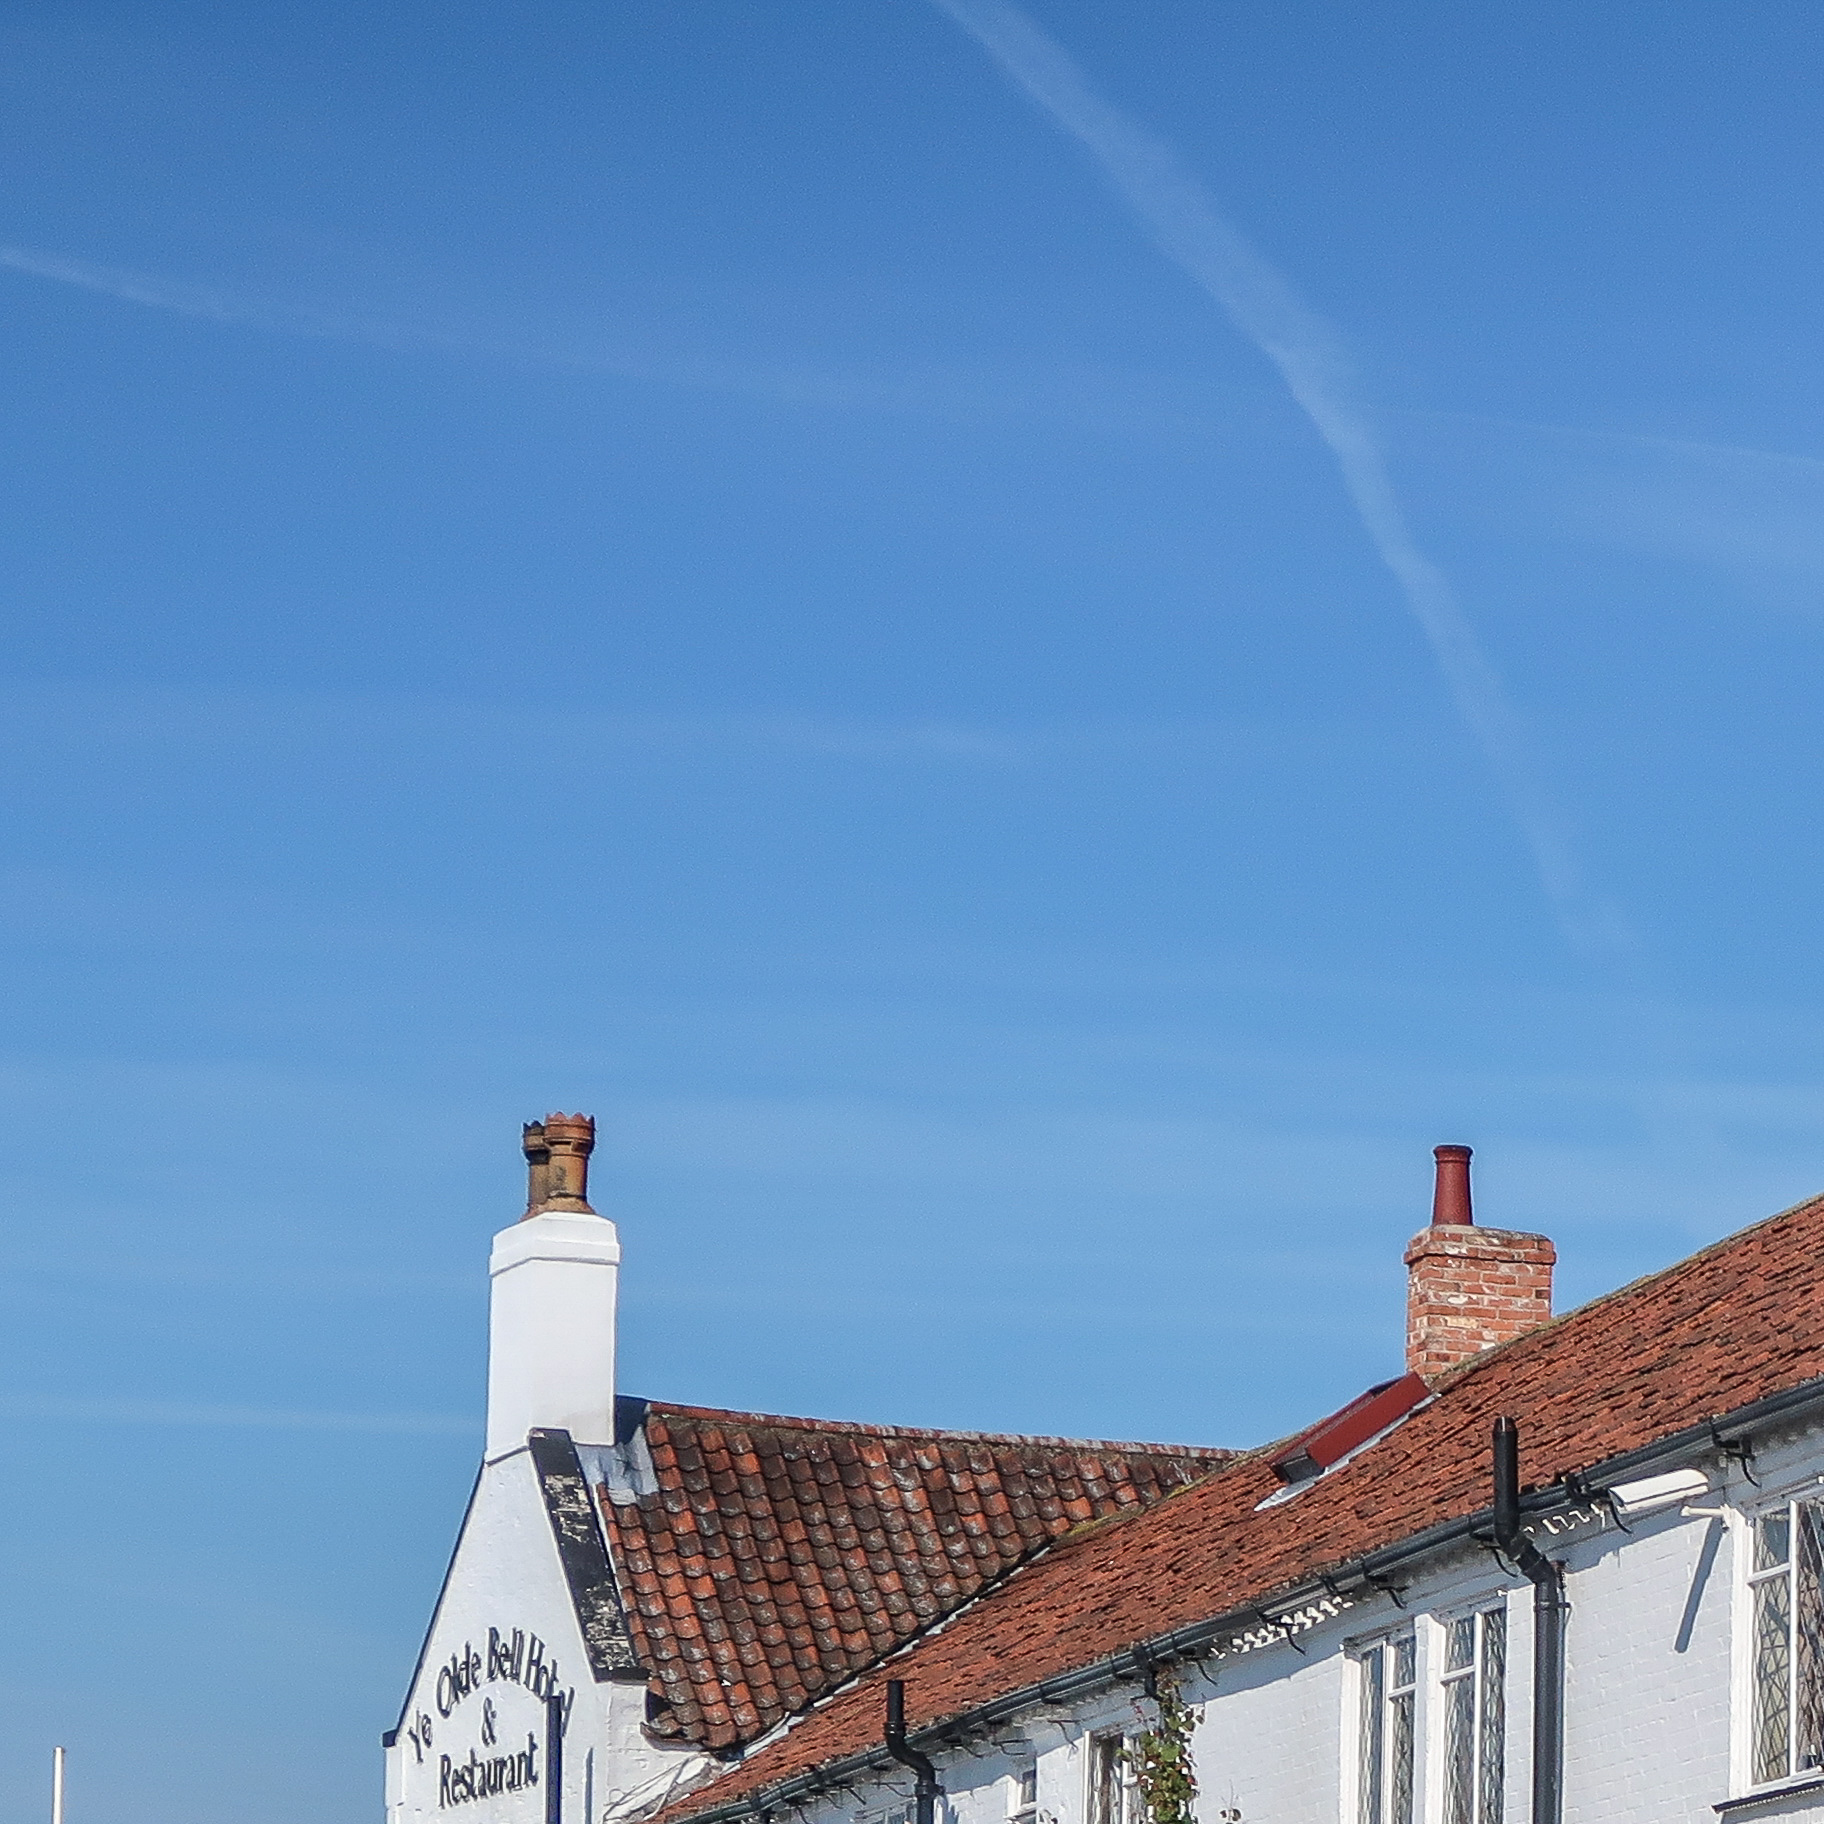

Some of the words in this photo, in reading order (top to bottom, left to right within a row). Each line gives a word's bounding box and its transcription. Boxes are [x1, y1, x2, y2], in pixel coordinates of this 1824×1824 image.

[407, 1707, 433, 1764] Ye
[436, 1641, 482, 1718] Olde
[487, 1627, 525, 1685] Bell
[482, 1697, 497, 1747] &
[438, 1731, 539, 1809] Restaurant
